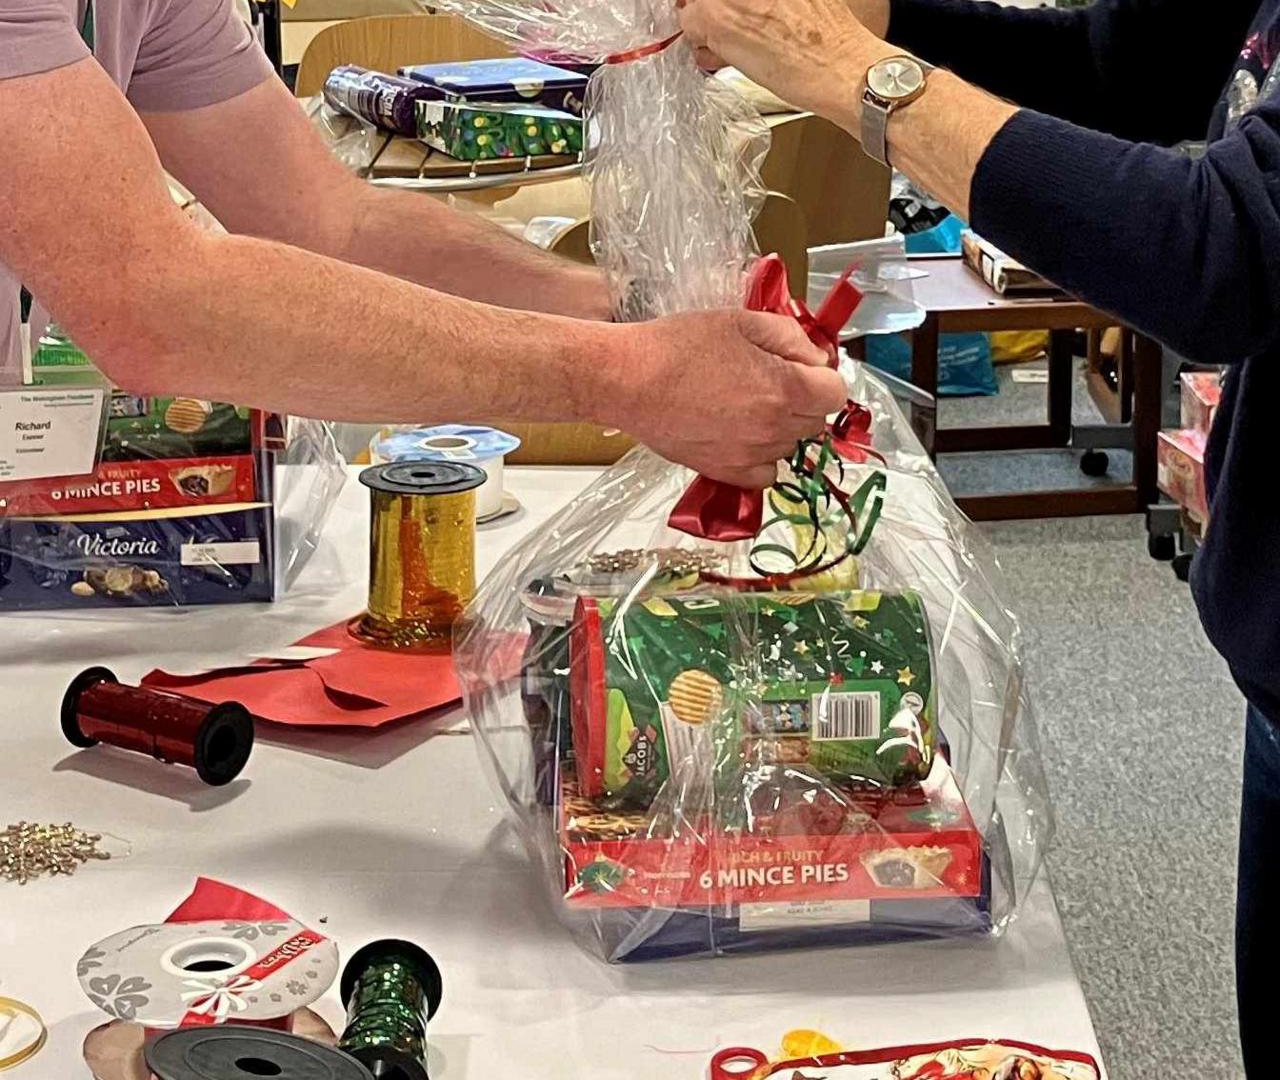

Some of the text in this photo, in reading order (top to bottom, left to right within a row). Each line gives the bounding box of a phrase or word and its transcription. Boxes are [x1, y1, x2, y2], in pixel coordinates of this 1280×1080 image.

[15, 421, 51, 431] Richard
[125, 477, 161, 494] PIES
[75, 532, 161, 557] Victoria
[776, 849, 823, 863] FRUITY
[699, 870, 713, 889] 6
[717, 865, 796, 888] MINCE
[800, 863, 849, 884] PIES
